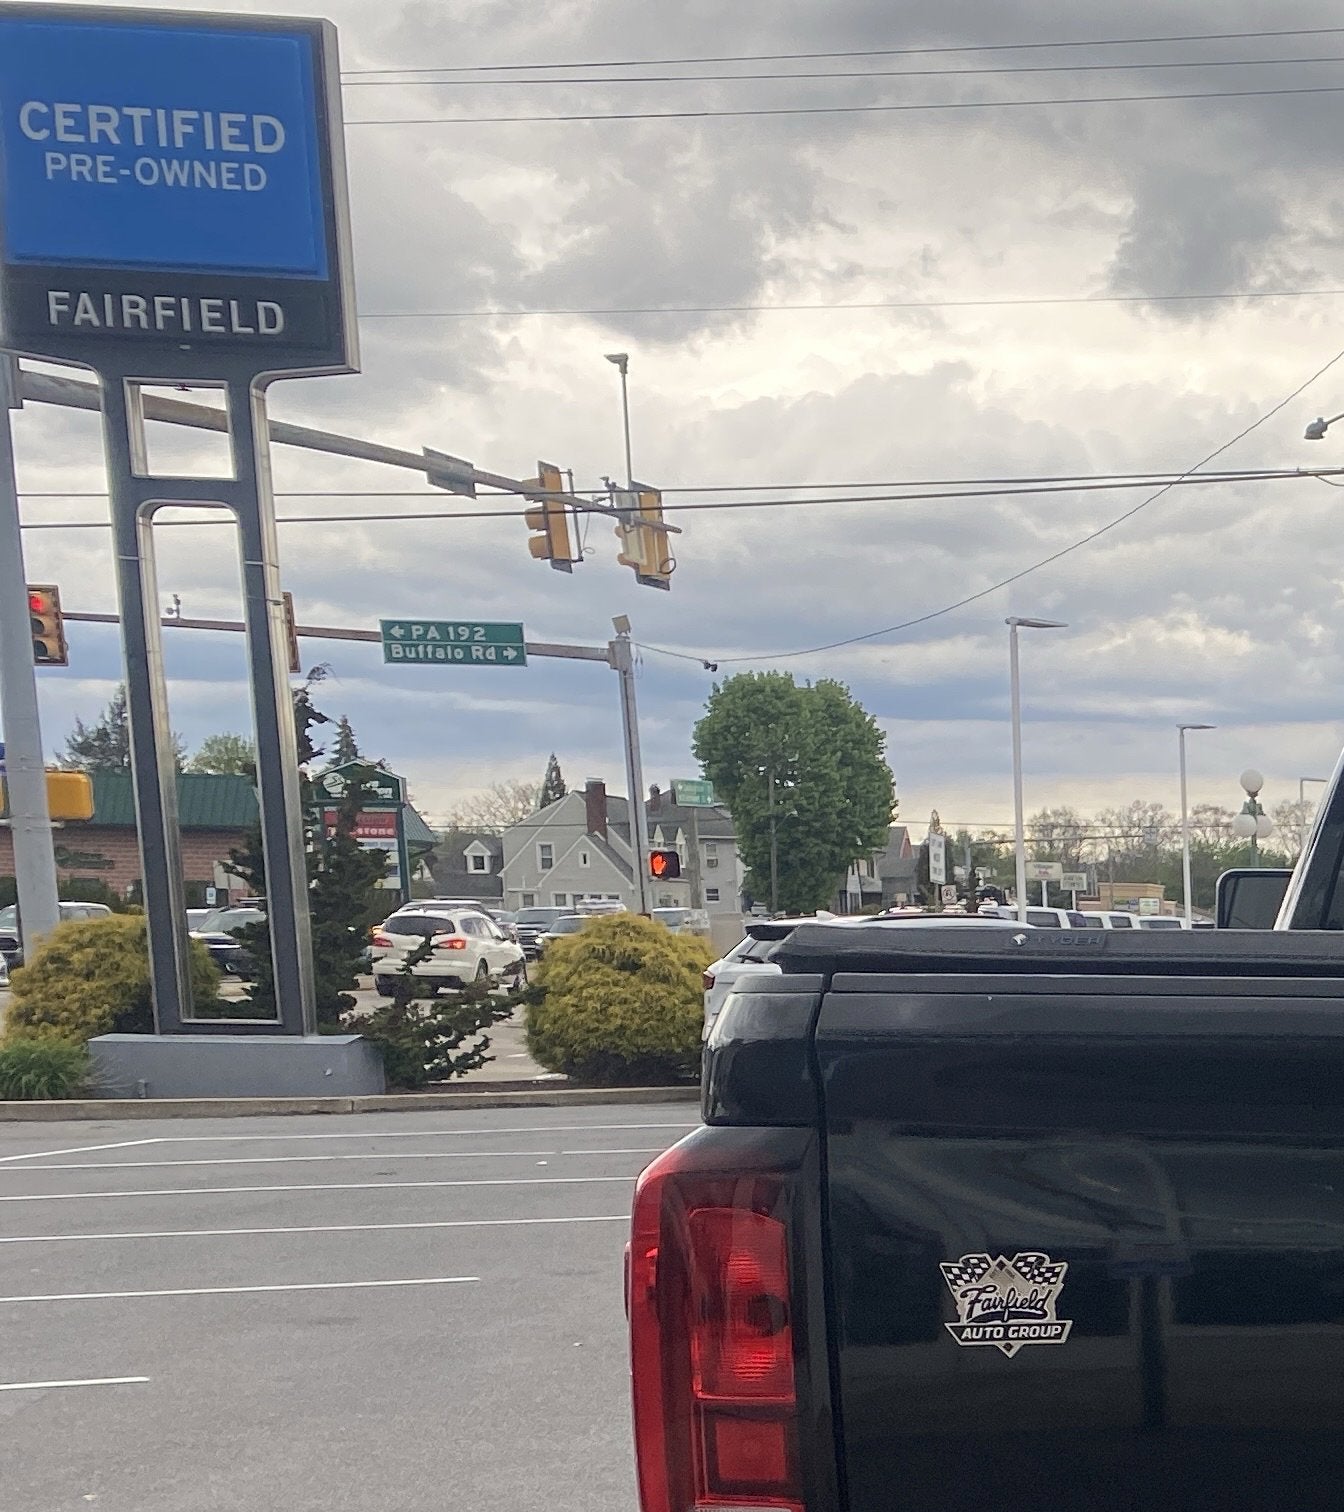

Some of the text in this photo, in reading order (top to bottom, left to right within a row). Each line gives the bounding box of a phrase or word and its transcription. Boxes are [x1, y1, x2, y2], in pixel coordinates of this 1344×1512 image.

[19, 101, 286, 153] CERTIFIED
[45, 152, 267, 191] PRE-OWNED
[48, 290, 285, 335] FAIRFIELD
[391, 643, 497, 660] Buffalo Rd
[411, 625, 486, 641] PA 192
[959, 1285, 1053, 1324] Fairfield
[961, 1325, 1062, 1340] AUTO GROUP
